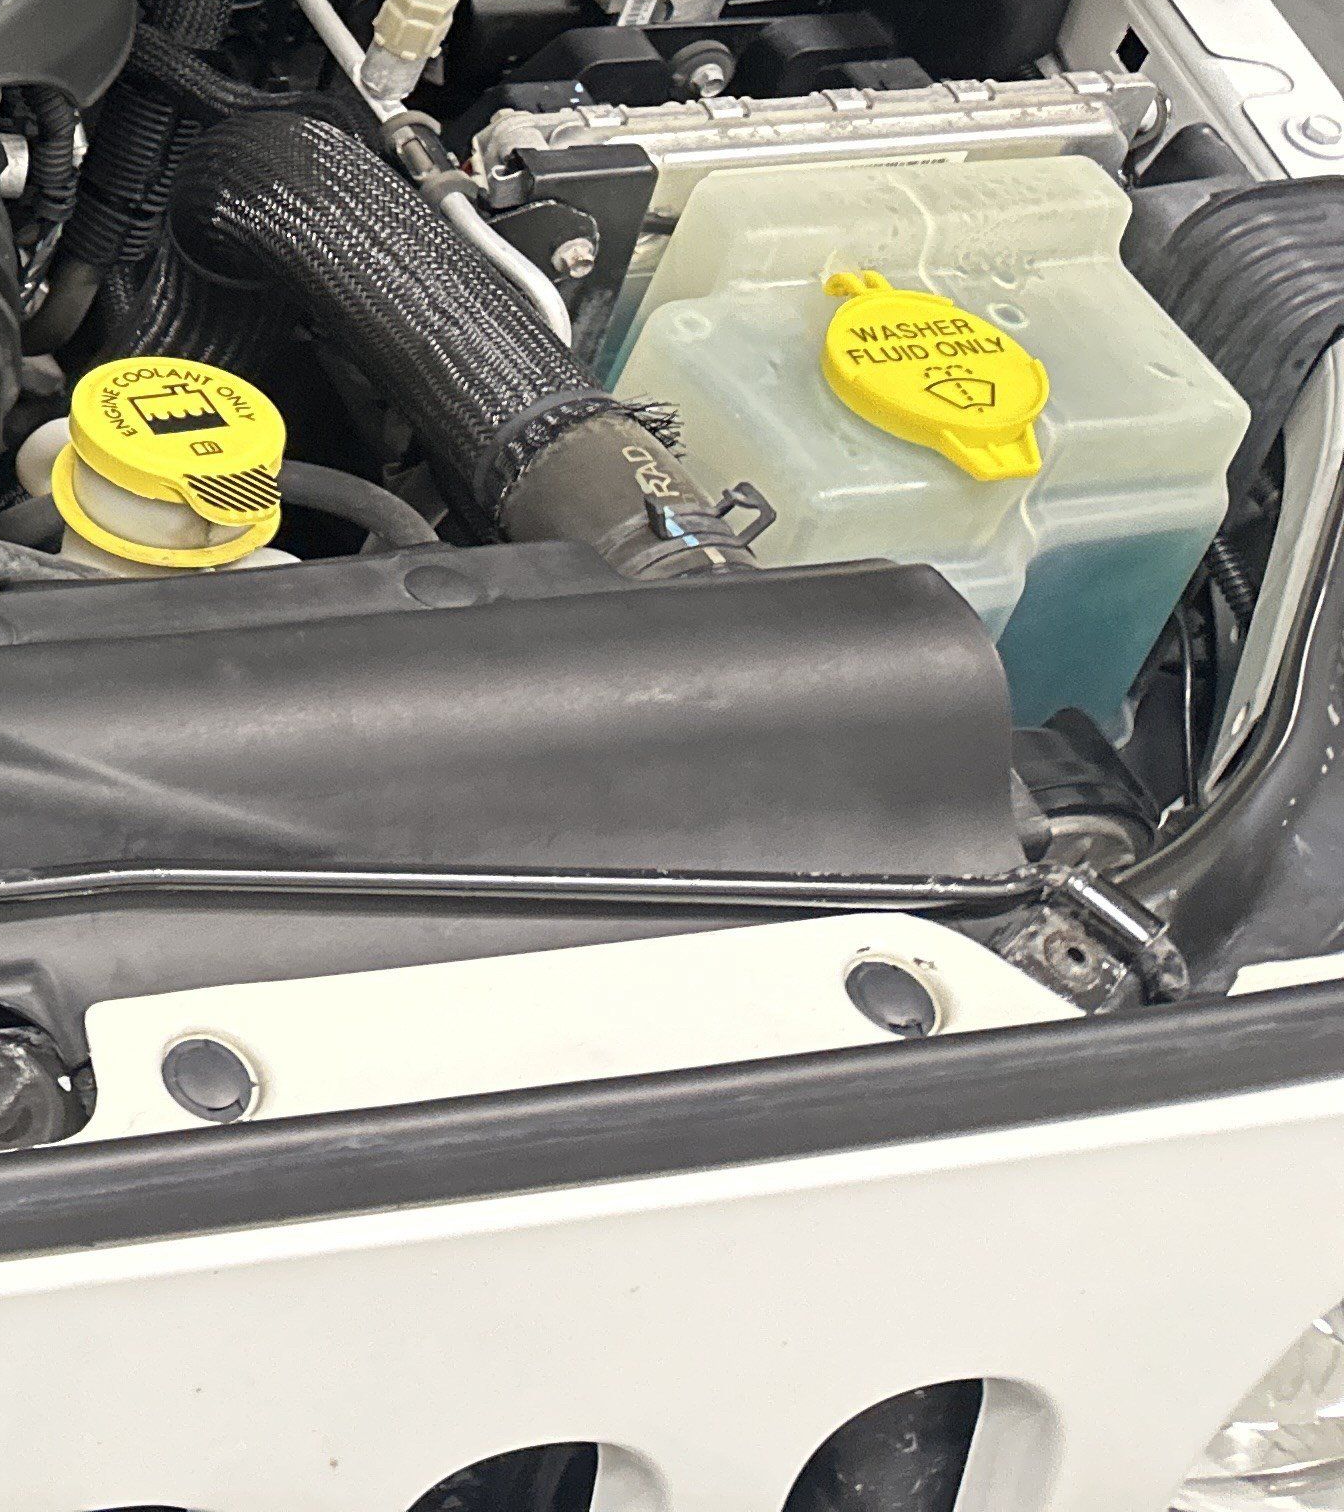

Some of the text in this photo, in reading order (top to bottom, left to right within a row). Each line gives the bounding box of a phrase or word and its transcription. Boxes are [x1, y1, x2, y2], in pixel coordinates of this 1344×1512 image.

[849, 318, 975, 343] WASHER
[846, 337, 1005, 365] FLUID ONLY
[101, 368, 255, 437] ENGINE COOLANT ONLY
